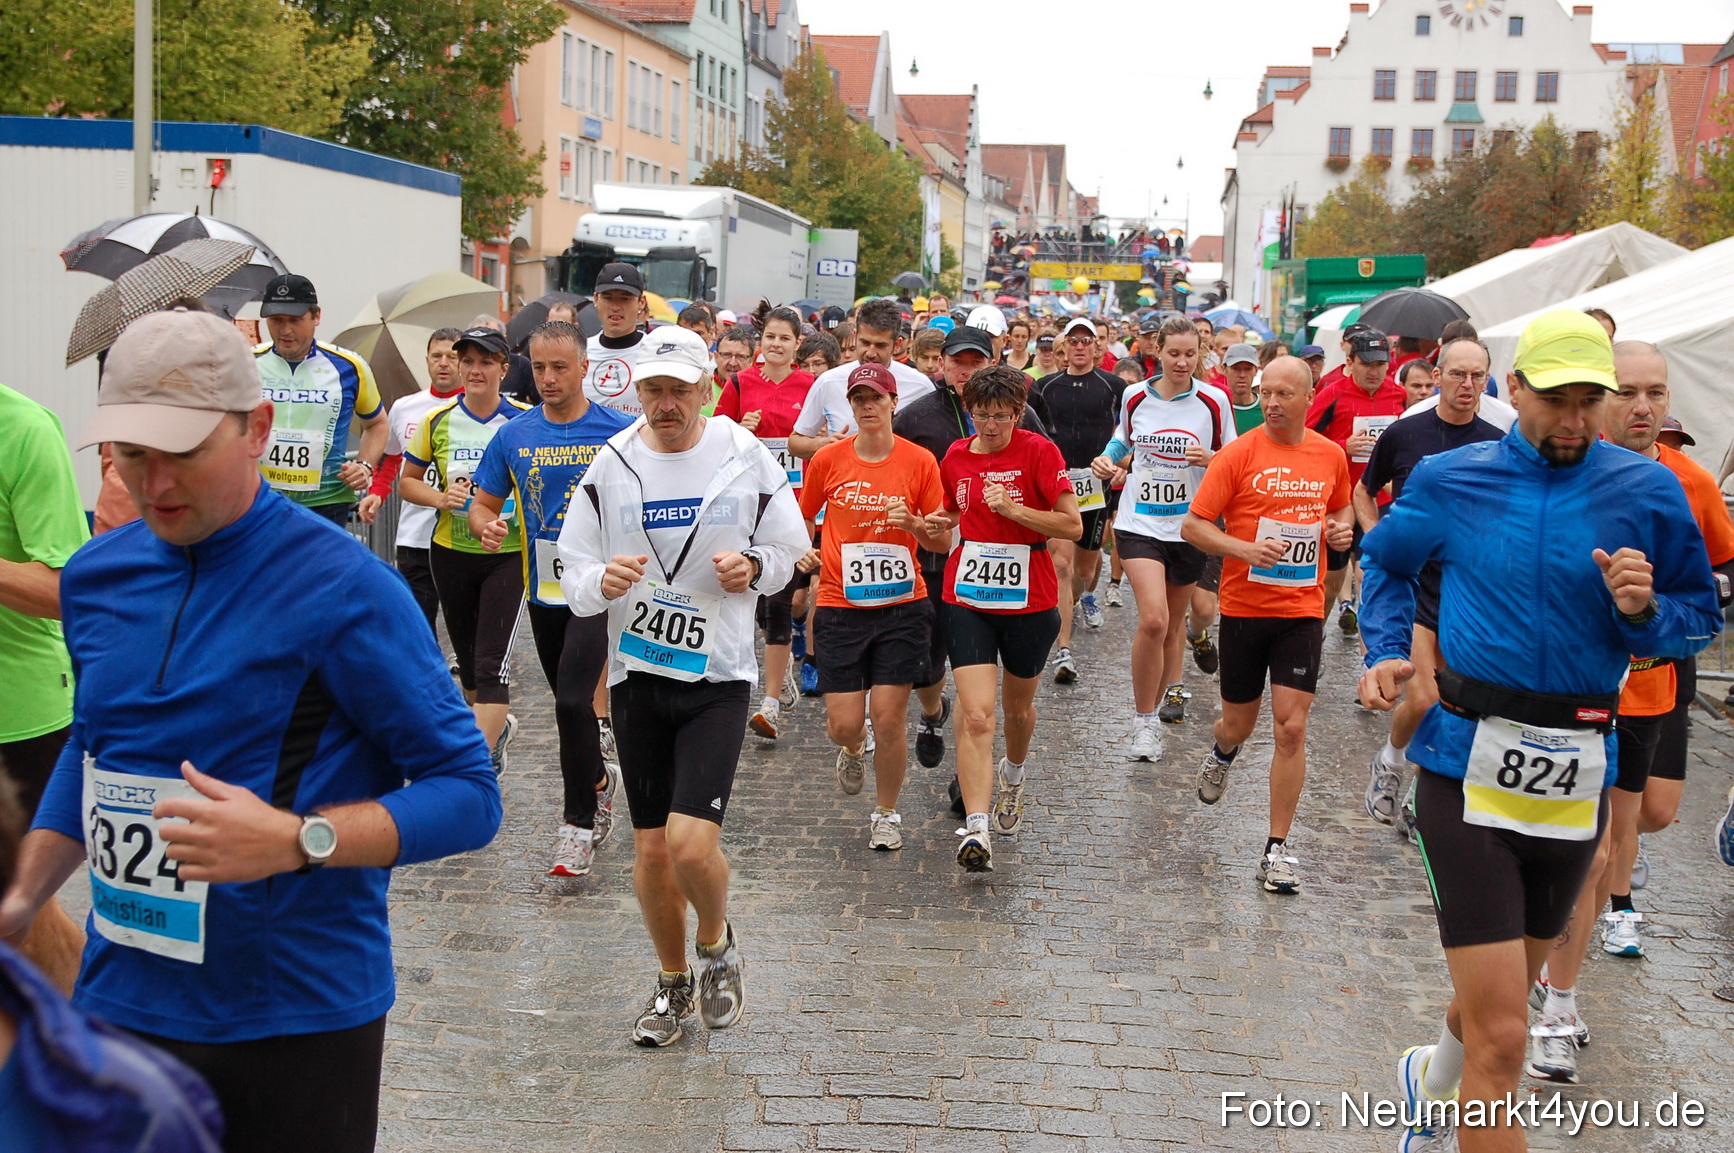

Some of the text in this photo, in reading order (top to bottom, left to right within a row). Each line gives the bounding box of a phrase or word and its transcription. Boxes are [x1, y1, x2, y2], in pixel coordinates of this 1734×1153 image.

[605, 225, 667, 241] BOCK
[1065, 266, 1104, 277] START
[261, 387, 329, 404] BOCK
[1136, 435, 1189, 446] GERHART
[268, 444, 310, 469] 448
[518, 448, 532, 457] 10.
[268, 469, 308, 484] Wolfgang
[1266, 477, 1326, 491] Fischer
[1140, 481, 1187, 503] 3104
[1148, 505, 1178, 515] Daniela
[1264, 536, 1318, 564] 208
[850, 559, 908, 584] 3163
[962, 558, 1022, 586] 2449
[1277, 567, 1297, 578] Kurt
[653, 588, 692, 604] BOCK
[863, 586, 896, 598] Andrea
[975, 589, 1003, 600] Maria
[630, 600, 707, 650] 2405
[644, 645, 674, 664] Erich
[1496, 748, 1580, 796] 824
[94, 882, 167, 929] Christian
